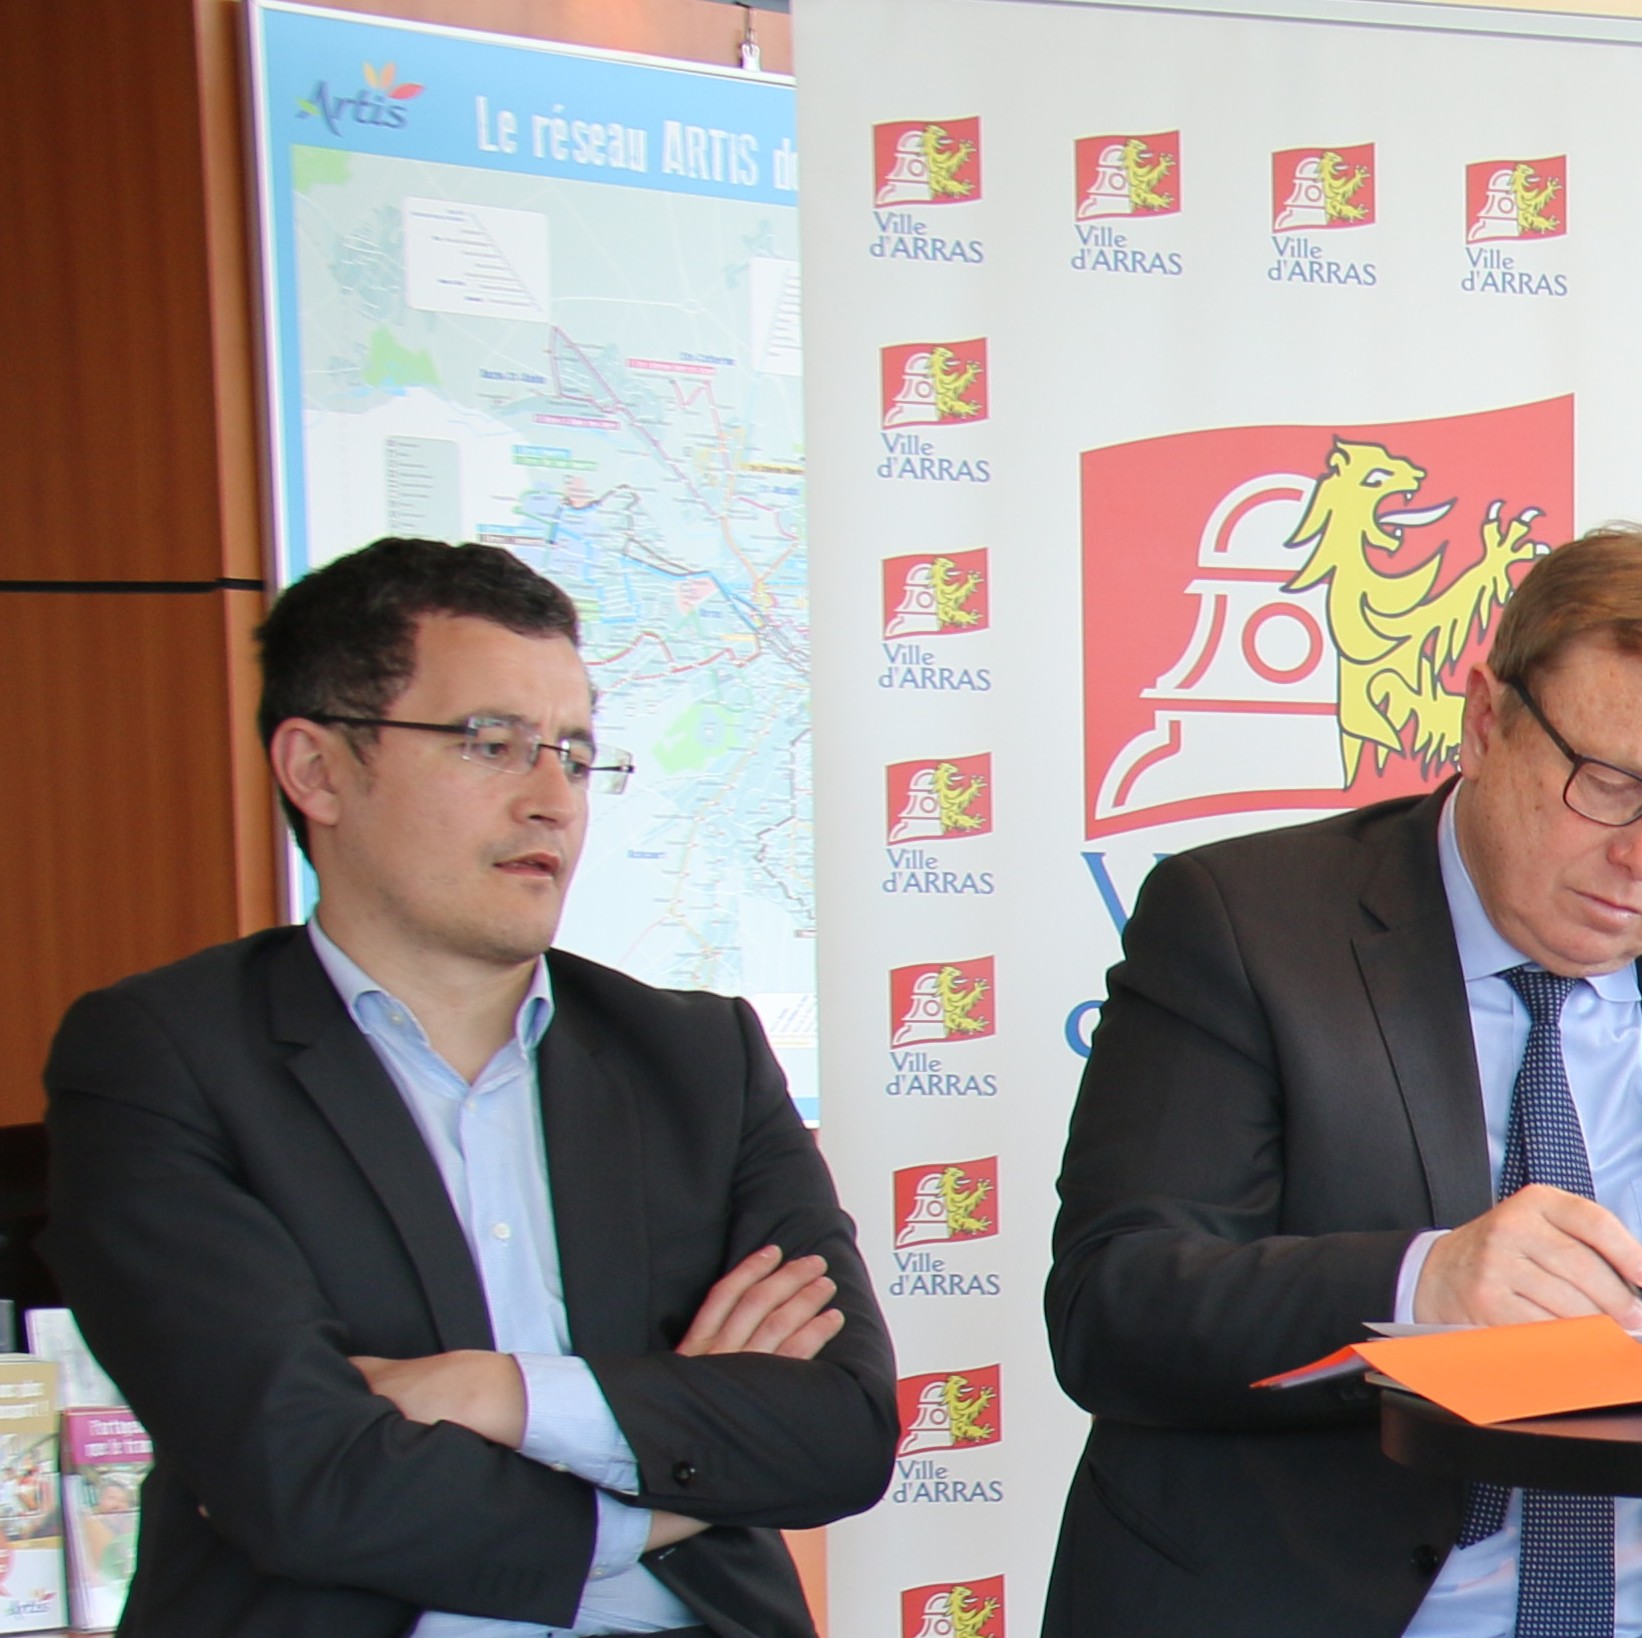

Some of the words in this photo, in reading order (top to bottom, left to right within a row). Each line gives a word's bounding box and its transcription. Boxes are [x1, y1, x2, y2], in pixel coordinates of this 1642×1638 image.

[295, 79, 408, 138] Artis
[475, 95, 518, 154] Le
[531, 103, 648, 173] réseau
[662, 119, 760, 187] ARTIS
[874, 211, 926, 236] Ville
[1075, 224, 1124, 248] Ville
[1271, 236, 1322, 260] Ville
[868, 235, 984, 263] d'ARRAS
[1465, 247, 1514, 271] Ville
[1071, 248, 1183, 275] d'ARRAS
[1267, 259, 1378, 286] d'ARRAS
[1461, 271, 1568, 296] d'ARRAS
[881, 432, 933, 456] Ville
[877, 457, 991, 483] d'ARRAS
[883, 643, 934, 666] Ville
[878, 666, 992, 691] d'ARRAS
[886, 848, 937, 870] Ville
[882, 871, 995, 895] d'ARRAS
[890, 1052, 941, 1073] Ville
[885, 1074, 998, 1097] d'ARRAS
[893, 1252, 944, 1273] Ville
[888, 1273, 1000, 1296] d'ARRAS
[896, 1460, 947, 1480] Ville
[892, 1481, 1003, 1504] d'ARRAS
